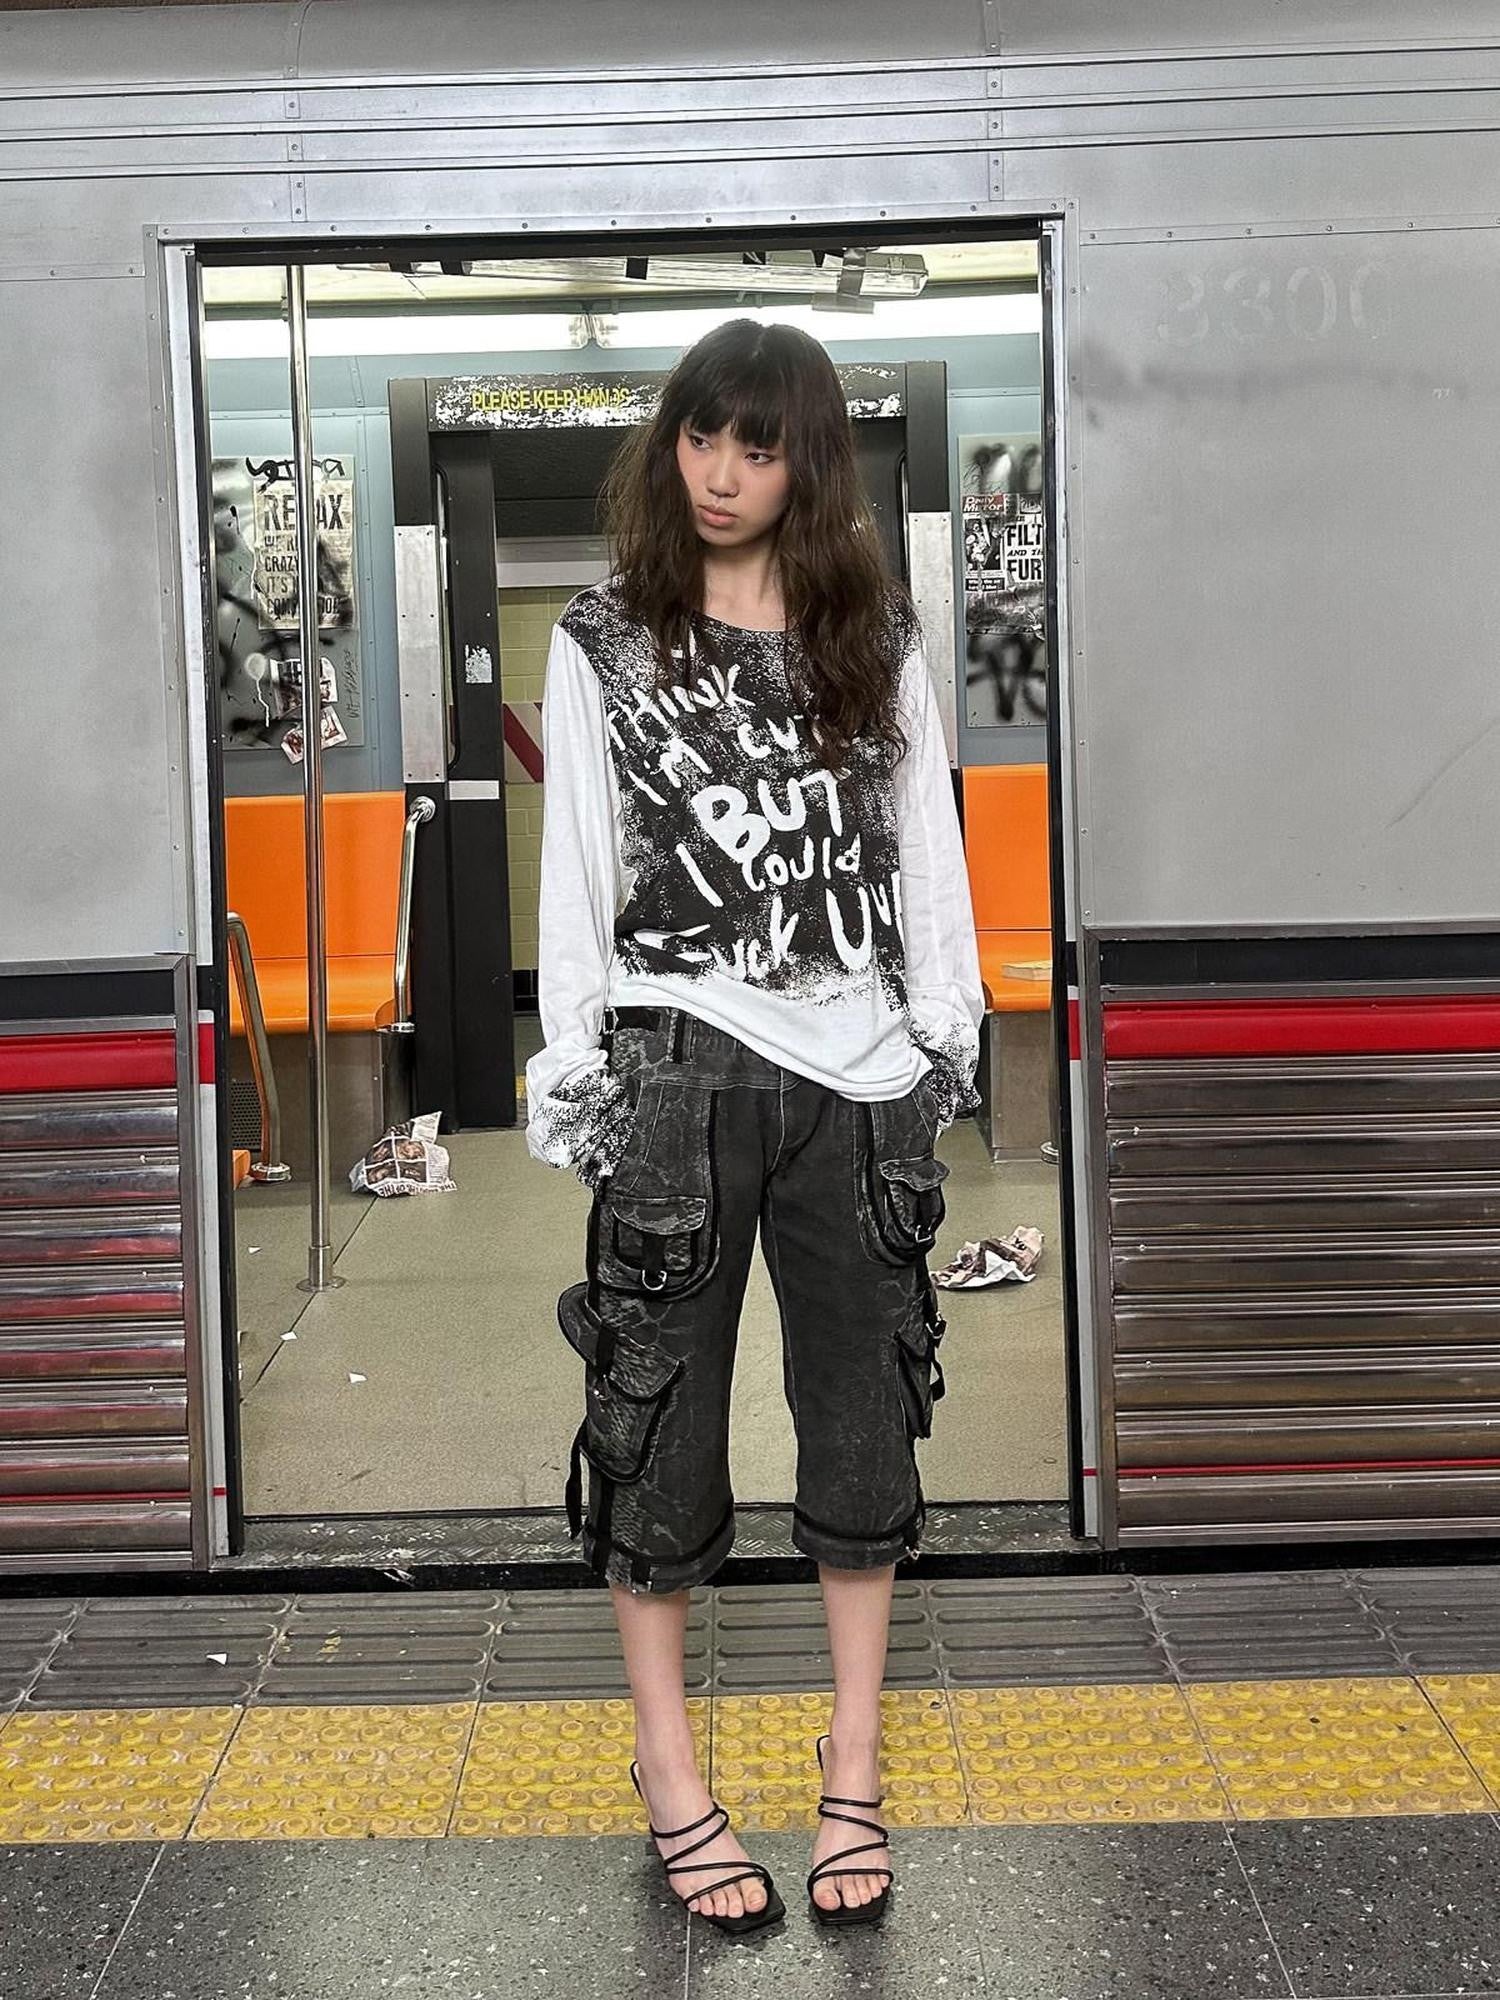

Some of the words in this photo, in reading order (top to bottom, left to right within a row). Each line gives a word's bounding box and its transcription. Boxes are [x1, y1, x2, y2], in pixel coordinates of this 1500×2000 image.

[472, 388, 530, 410] PLEASE
[264, 494, 343, 530] REAX
[964, 503, 1003, 512] Miror
[690, 766, 852, 864] BUT
